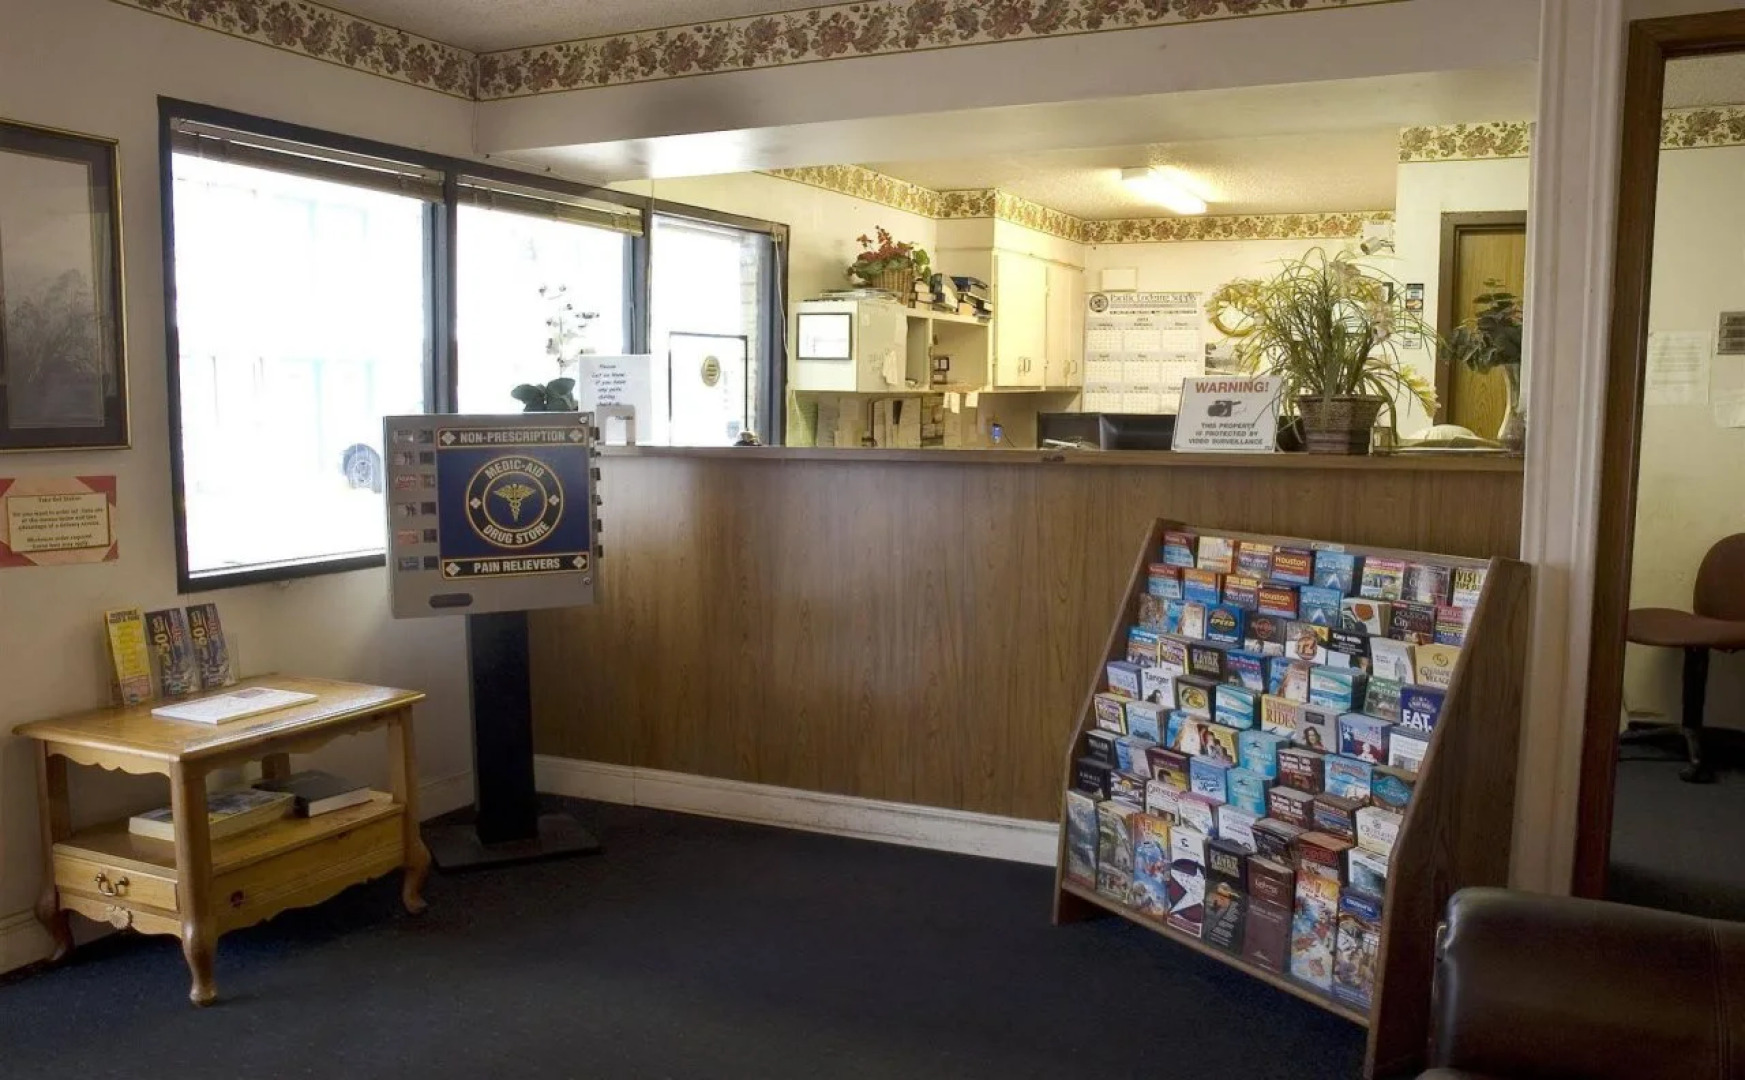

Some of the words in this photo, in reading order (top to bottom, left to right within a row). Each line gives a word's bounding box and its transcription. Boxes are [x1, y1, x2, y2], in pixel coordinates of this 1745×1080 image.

[1195, 381, 1269, 393] WARNING!
[460, 430, 566, 443] NON-PRESCRIPTION
[484, 459, 545, 480] MEDIC-AID
[483, 524, 513, 544] DRUG
[516, 521, 550, 544] STORE
[473, 562, 500, 574] PAIN
[502, 558, 561, 573] RELIEVERS
[1275, 556, 1307, 567] Houston
[1259, 591, 1291, 603] Houston
[1210, 617, 1235, 627] SPEED
[1144, 671, 1169, 684] Tanger
[1266, 710, 1296, 729] RIDES
[1401, 708, 1433, 733] EAT.
